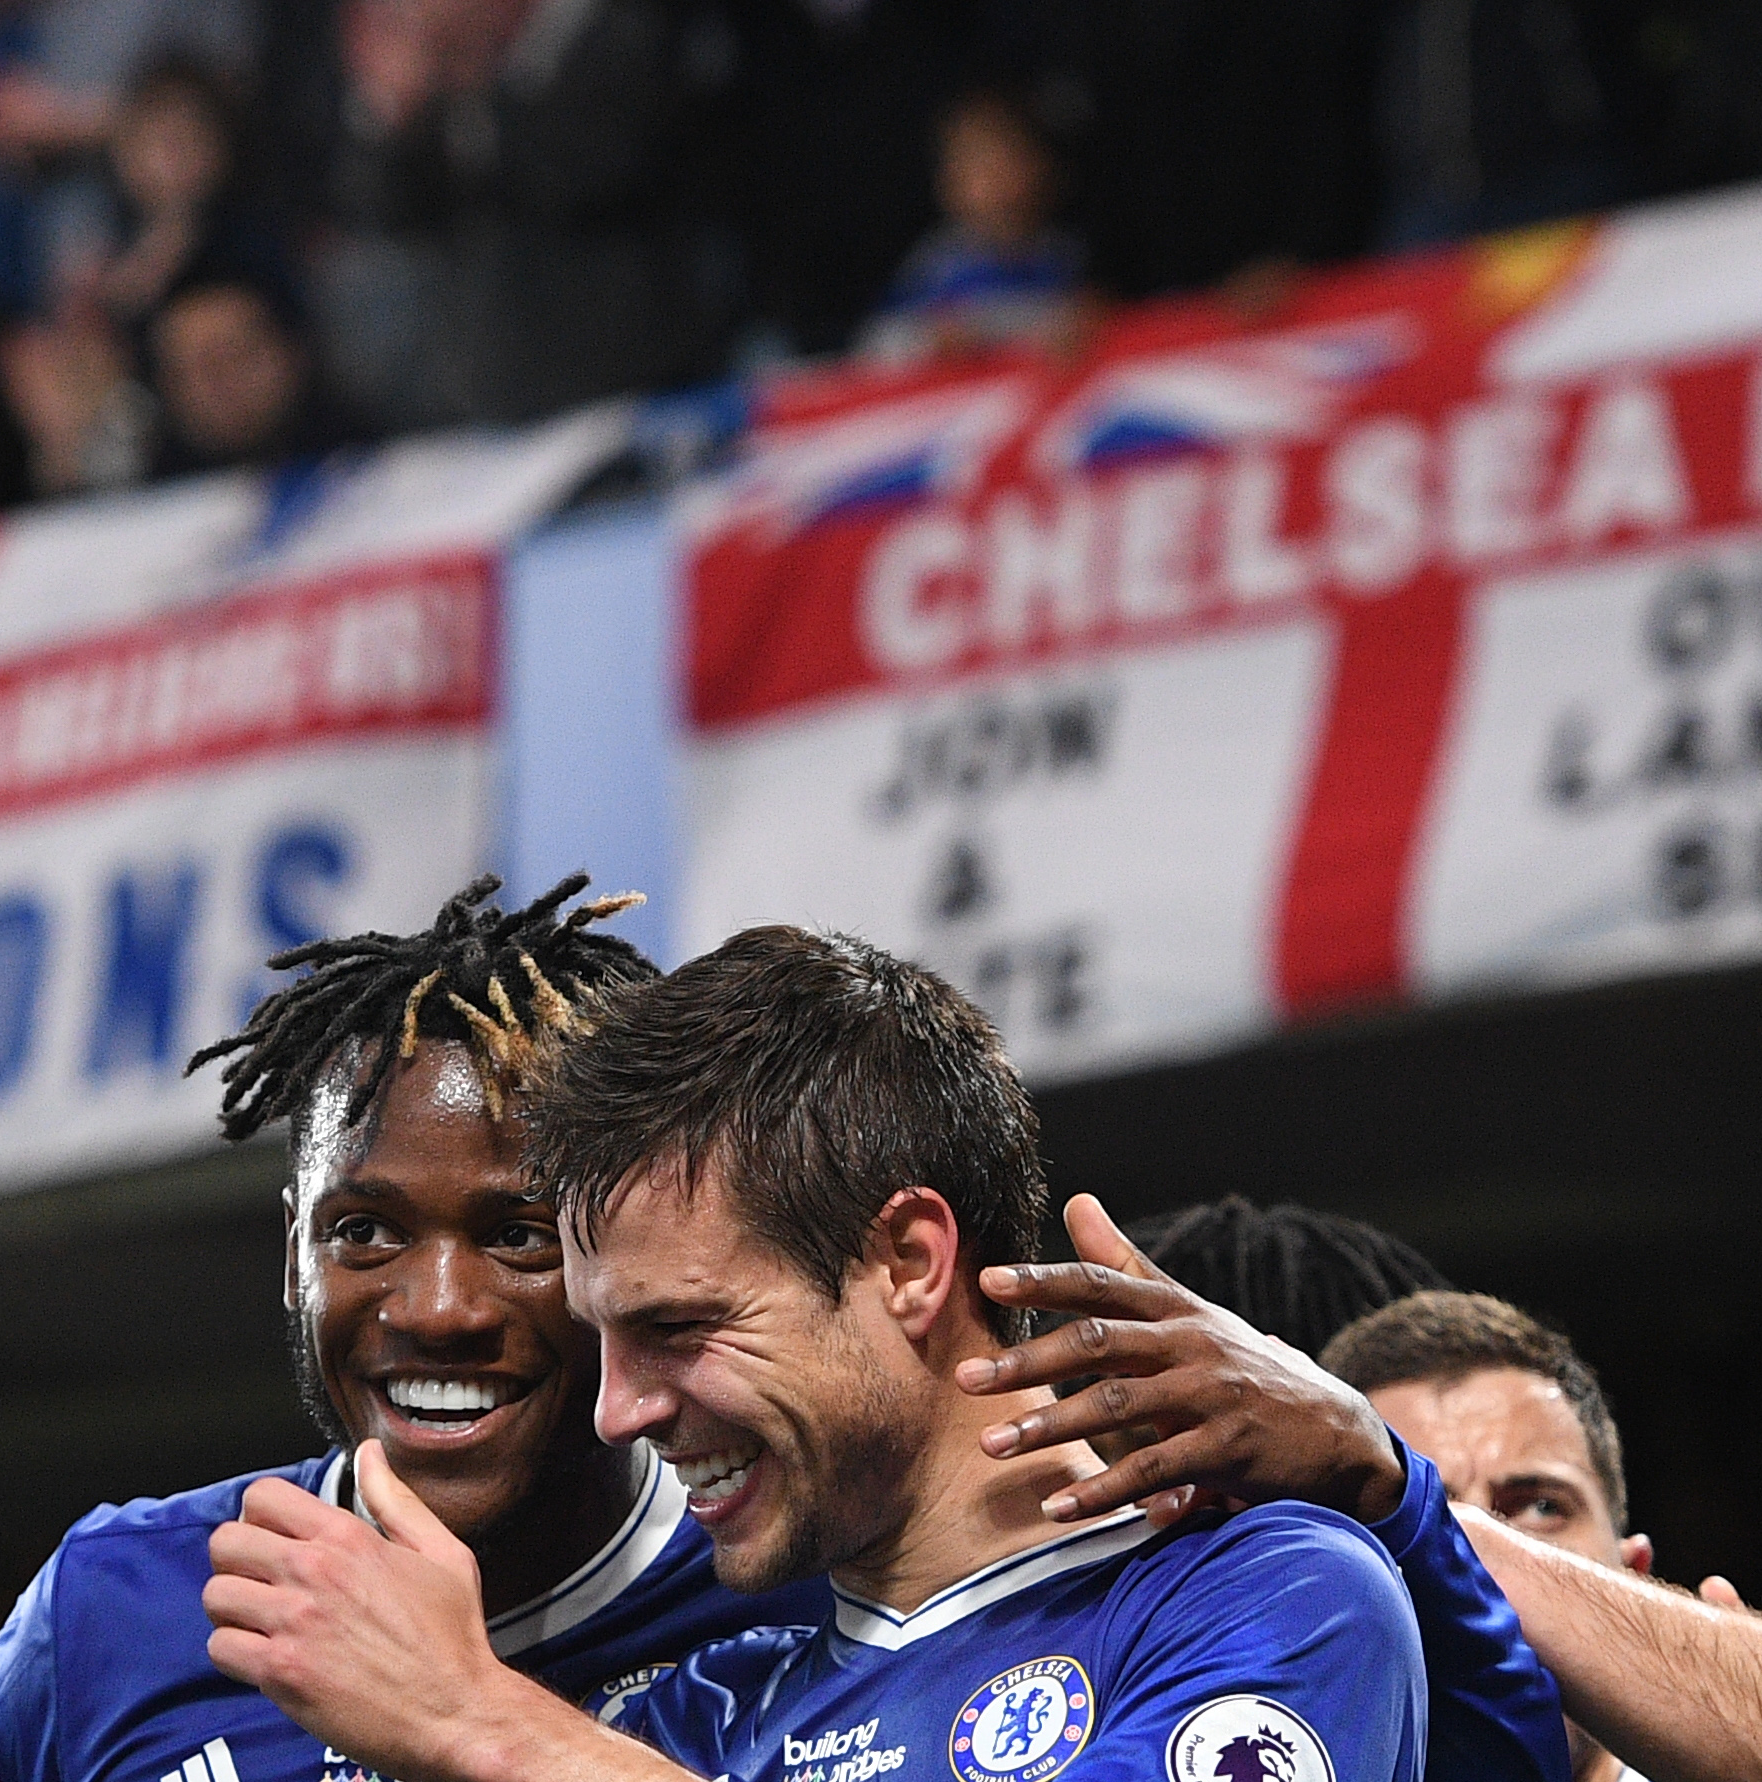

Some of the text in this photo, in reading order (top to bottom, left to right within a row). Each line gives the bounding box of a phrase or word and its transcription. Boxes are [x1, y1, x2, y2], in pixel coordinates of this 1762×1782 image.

[859, 385, 1693, 678] CHELSEA
[990, 1660, 1074, 1695] CHELSEA
[1022, 1755, 1057, 1780] CLUB
[1184, 1733, 1206, 1777] Premier
